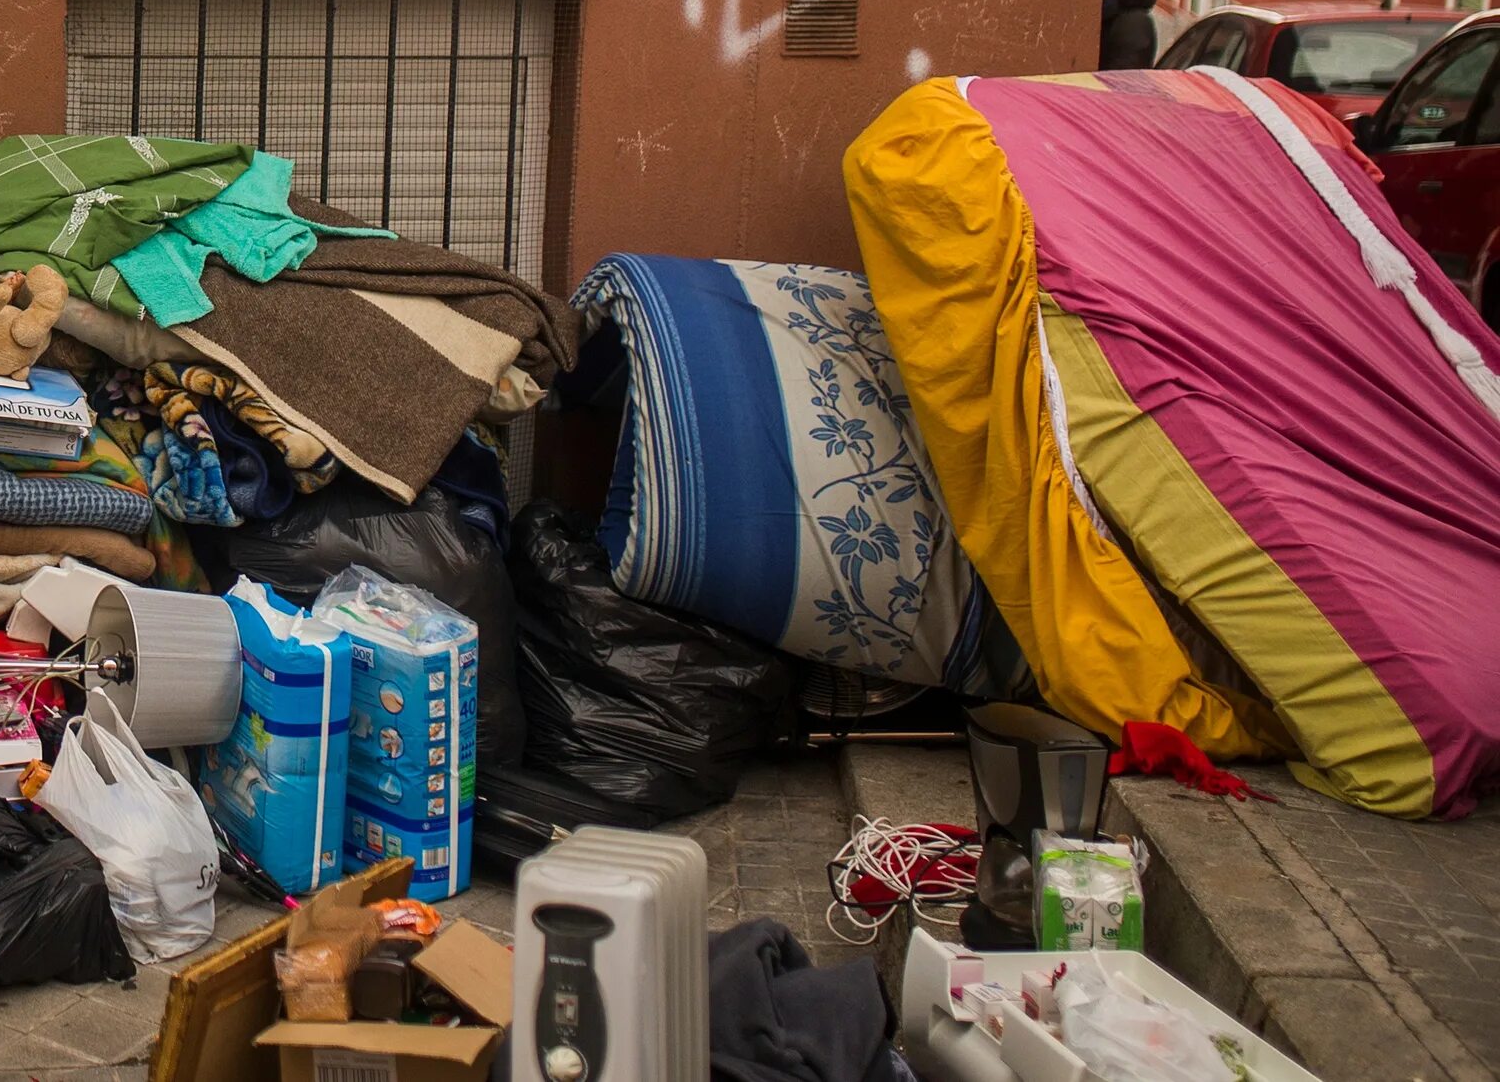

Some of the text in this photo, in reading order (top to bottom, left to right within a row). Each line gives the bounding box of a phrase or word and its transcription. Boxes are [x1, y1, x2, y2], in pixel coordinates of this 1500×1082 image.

[18, 405, 33, 416] DE
[35, 407, 51, 418] TU
[54, 410, 83, 422] CASA
[460, 697, 476, 718] 40
